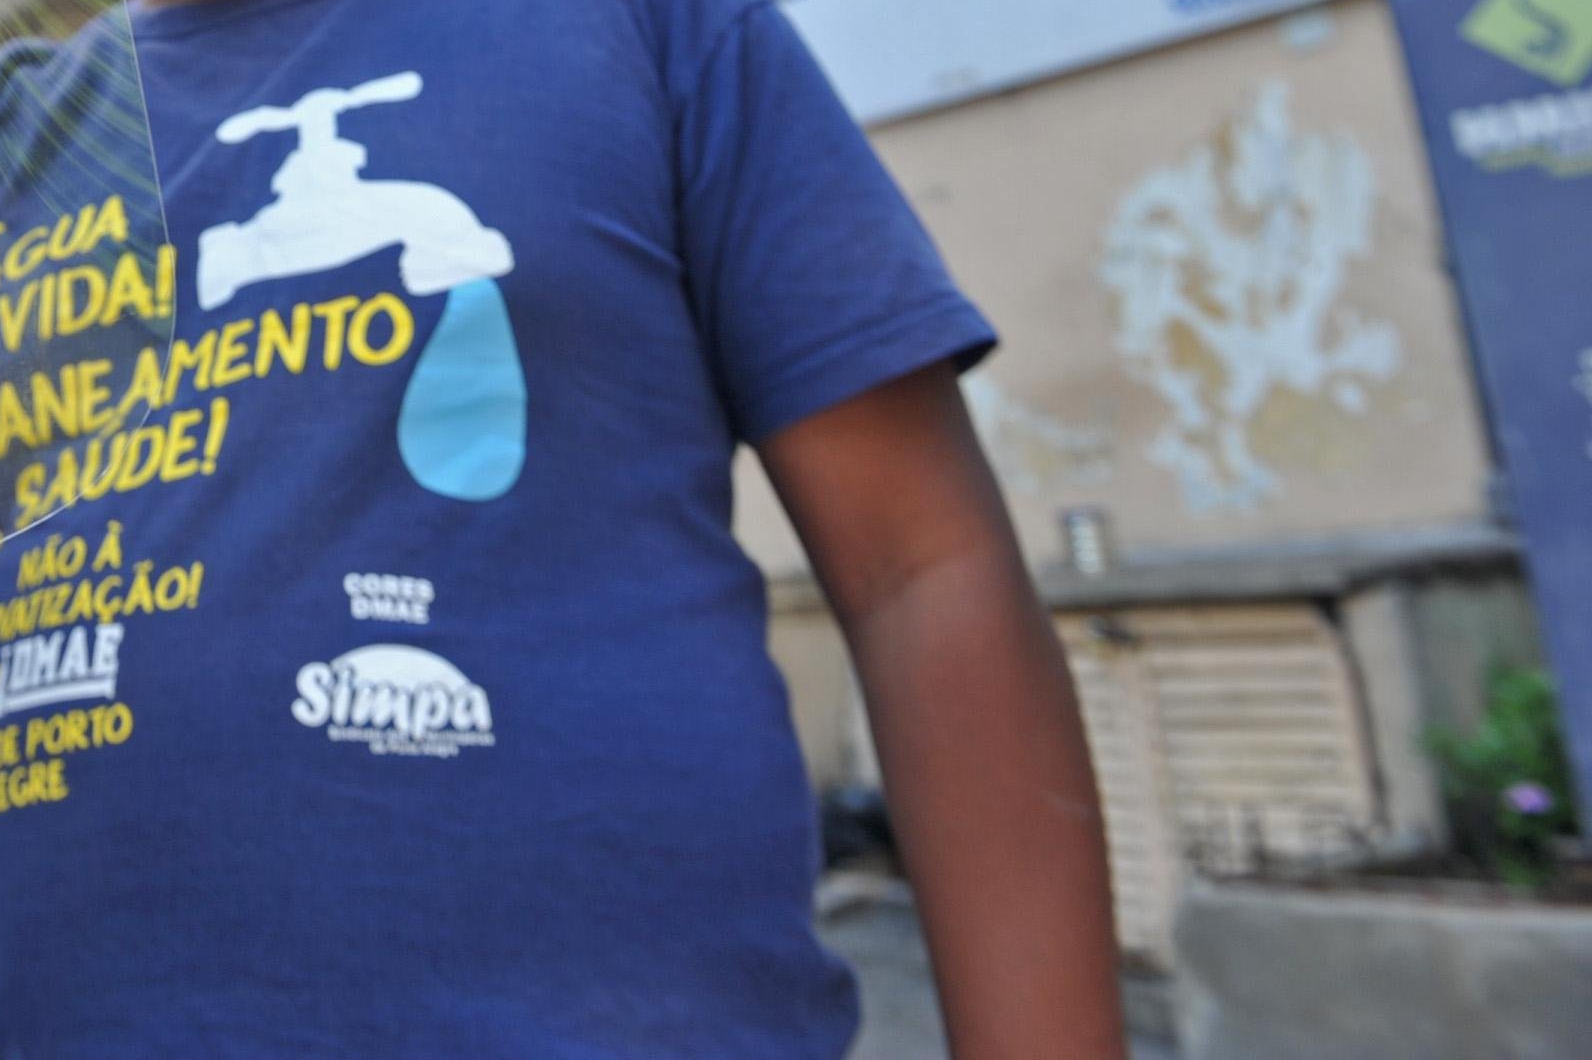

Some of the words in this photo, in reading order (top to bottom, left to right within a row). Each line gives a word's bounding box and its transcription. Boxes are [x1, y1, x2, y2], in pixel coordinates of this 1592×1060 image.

[14, 397, 230, 532] SAÚDE!
[17, 533, 87, 591] NÃO
[343, 572, 435, 604] CORES
[350, 596, 430, 625] DMAE
[10, 623, 124, 691] DMAE
[291, 661, 492, 740] Simpa
[25, 702, 134, 761] PORTO
